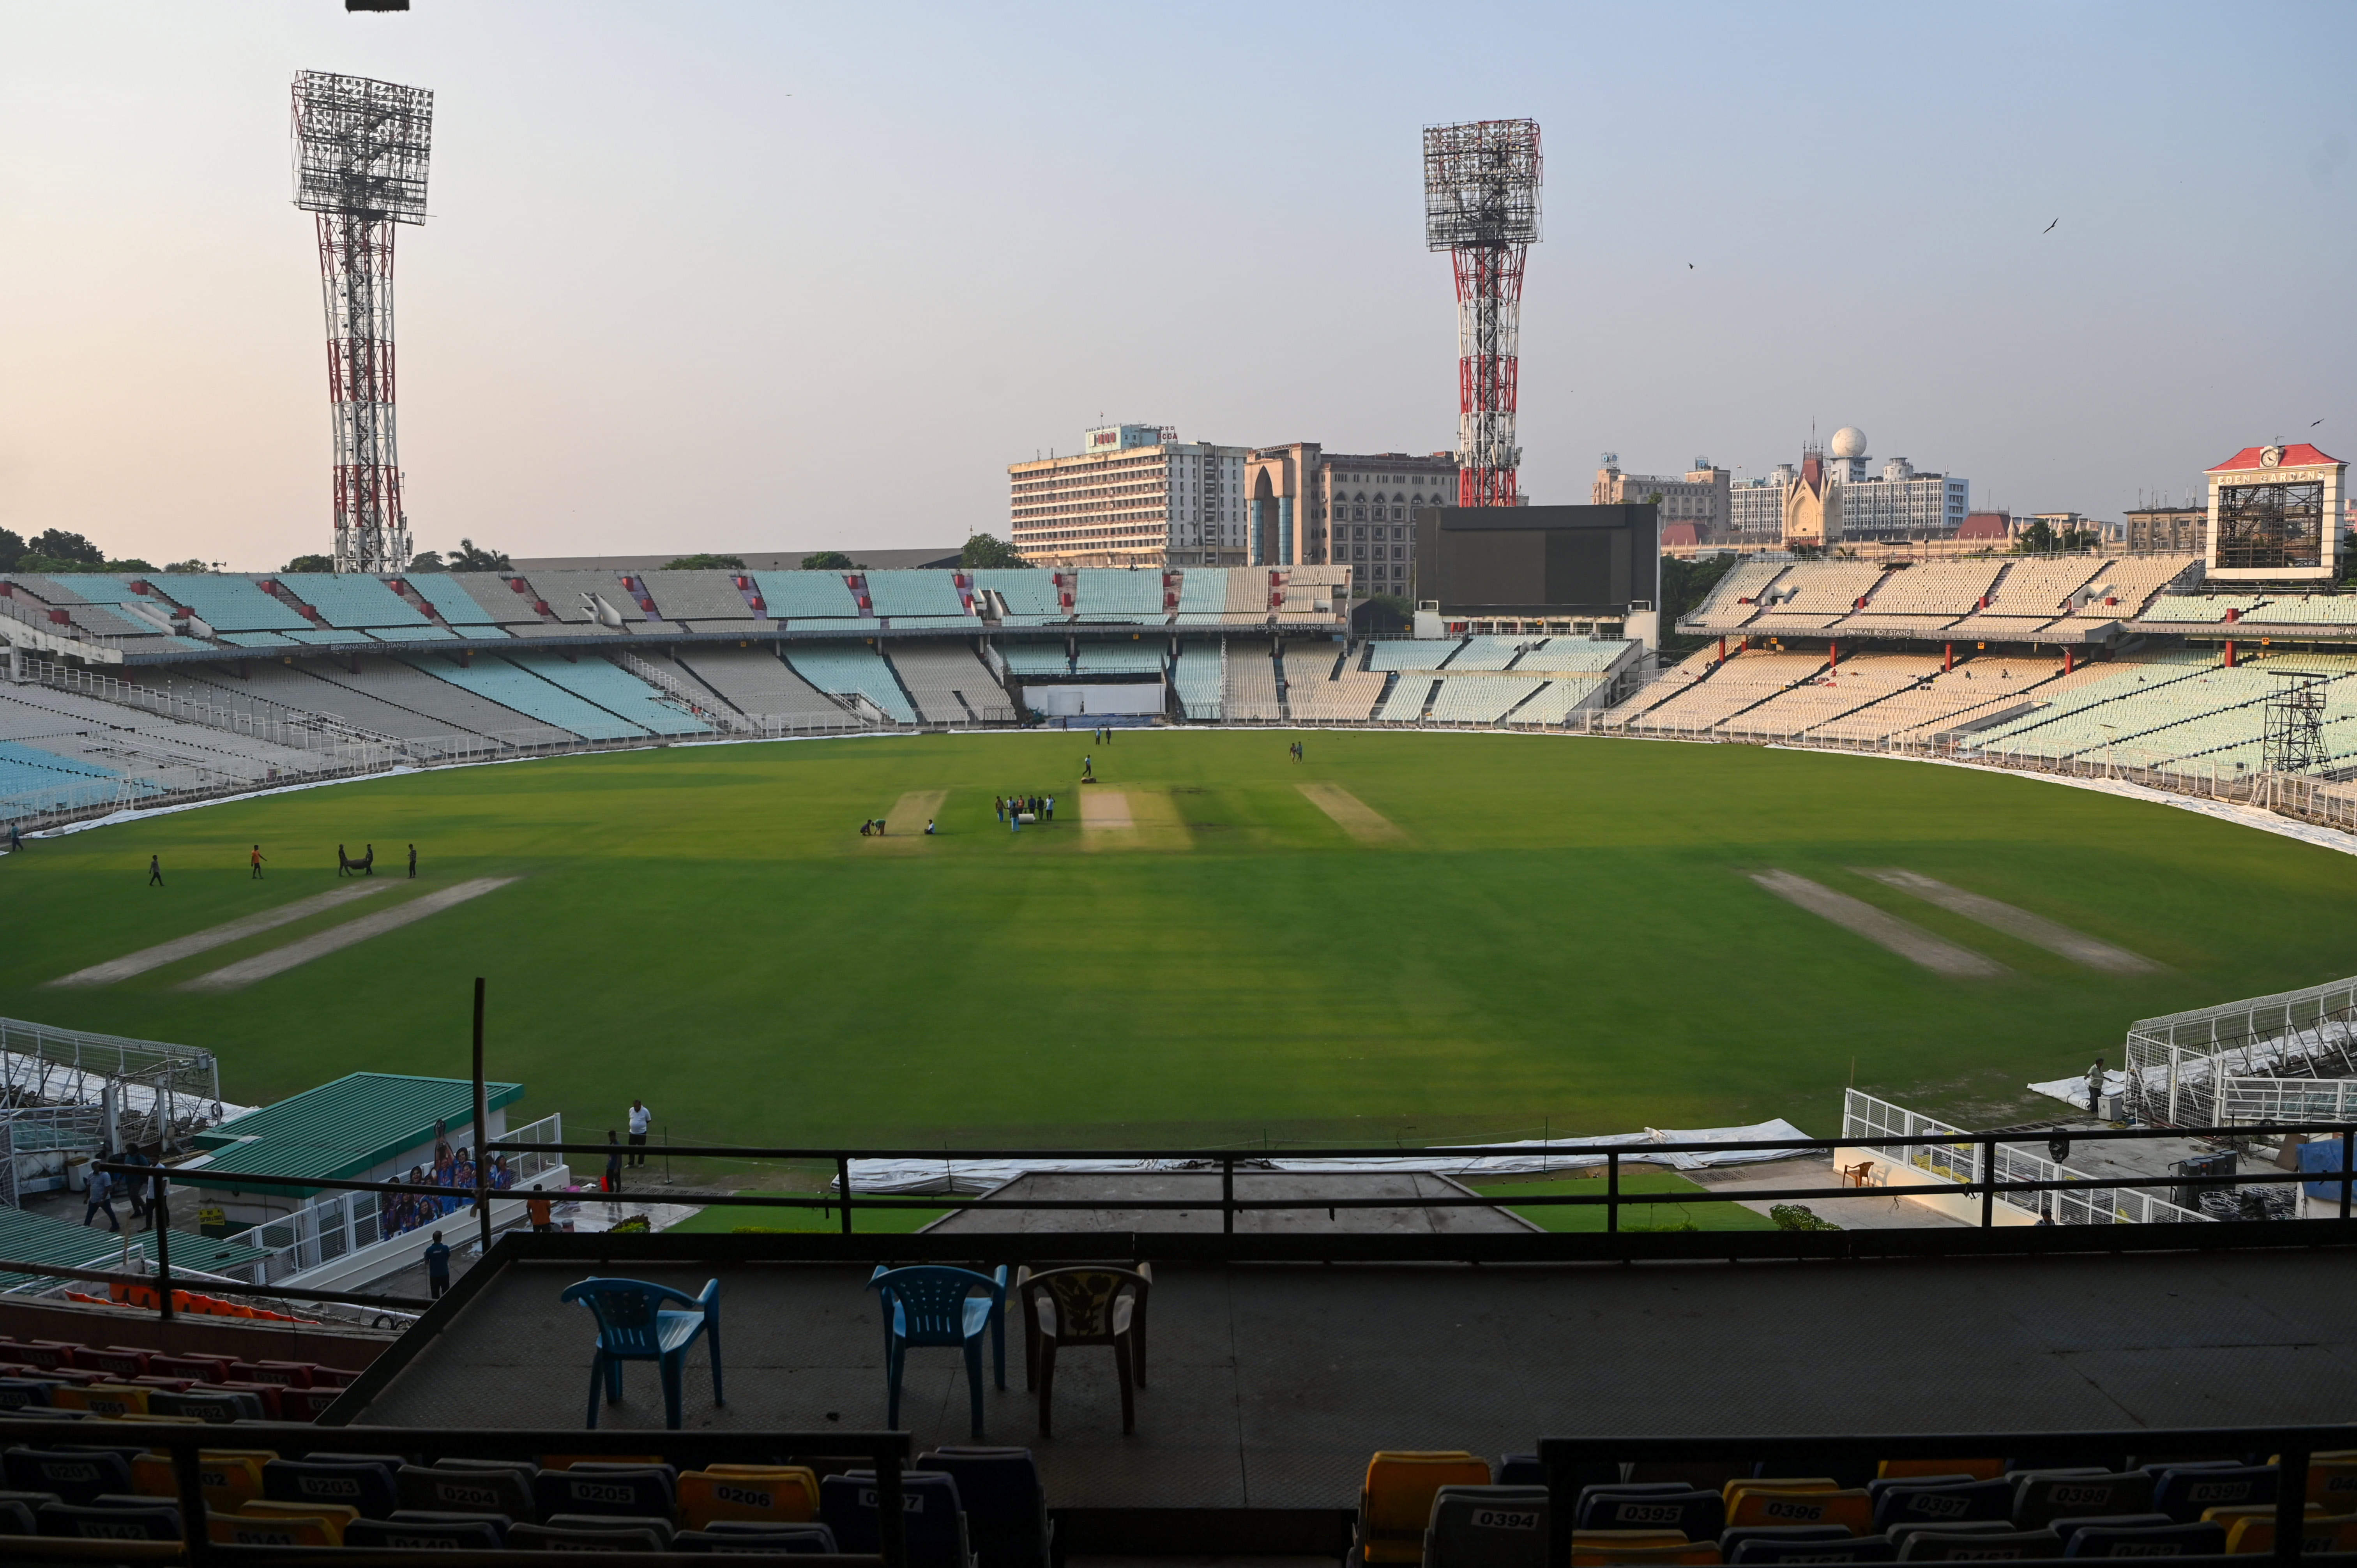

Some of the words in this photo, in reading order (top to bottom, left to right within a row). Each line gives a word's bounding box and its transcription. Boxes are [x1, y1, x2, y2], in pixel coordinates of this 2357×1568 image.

[2217, 475, 2251, 485] EDEN
[2260, 470, 2325, 482] GARDENS
[202, 1473, 226, 1486] 02
[306, 1479, 356, 1494] 0203
[444, 1487, 495, 1504] 0204
[578, 1485, 631, 1501] 0205
[718, 1486, 770, 1507] 0206
[866, 1491, 920, 1509] 07
[2056, 1488, 2108, 1503] 0398
[1624, 1506, 1678, 1521] 0395
[1768, 1503, 1822, 1519] 0396
[1917, 1497, 1965, 1515] 0397
[1481, 1512, 1534, 1527] 0394
